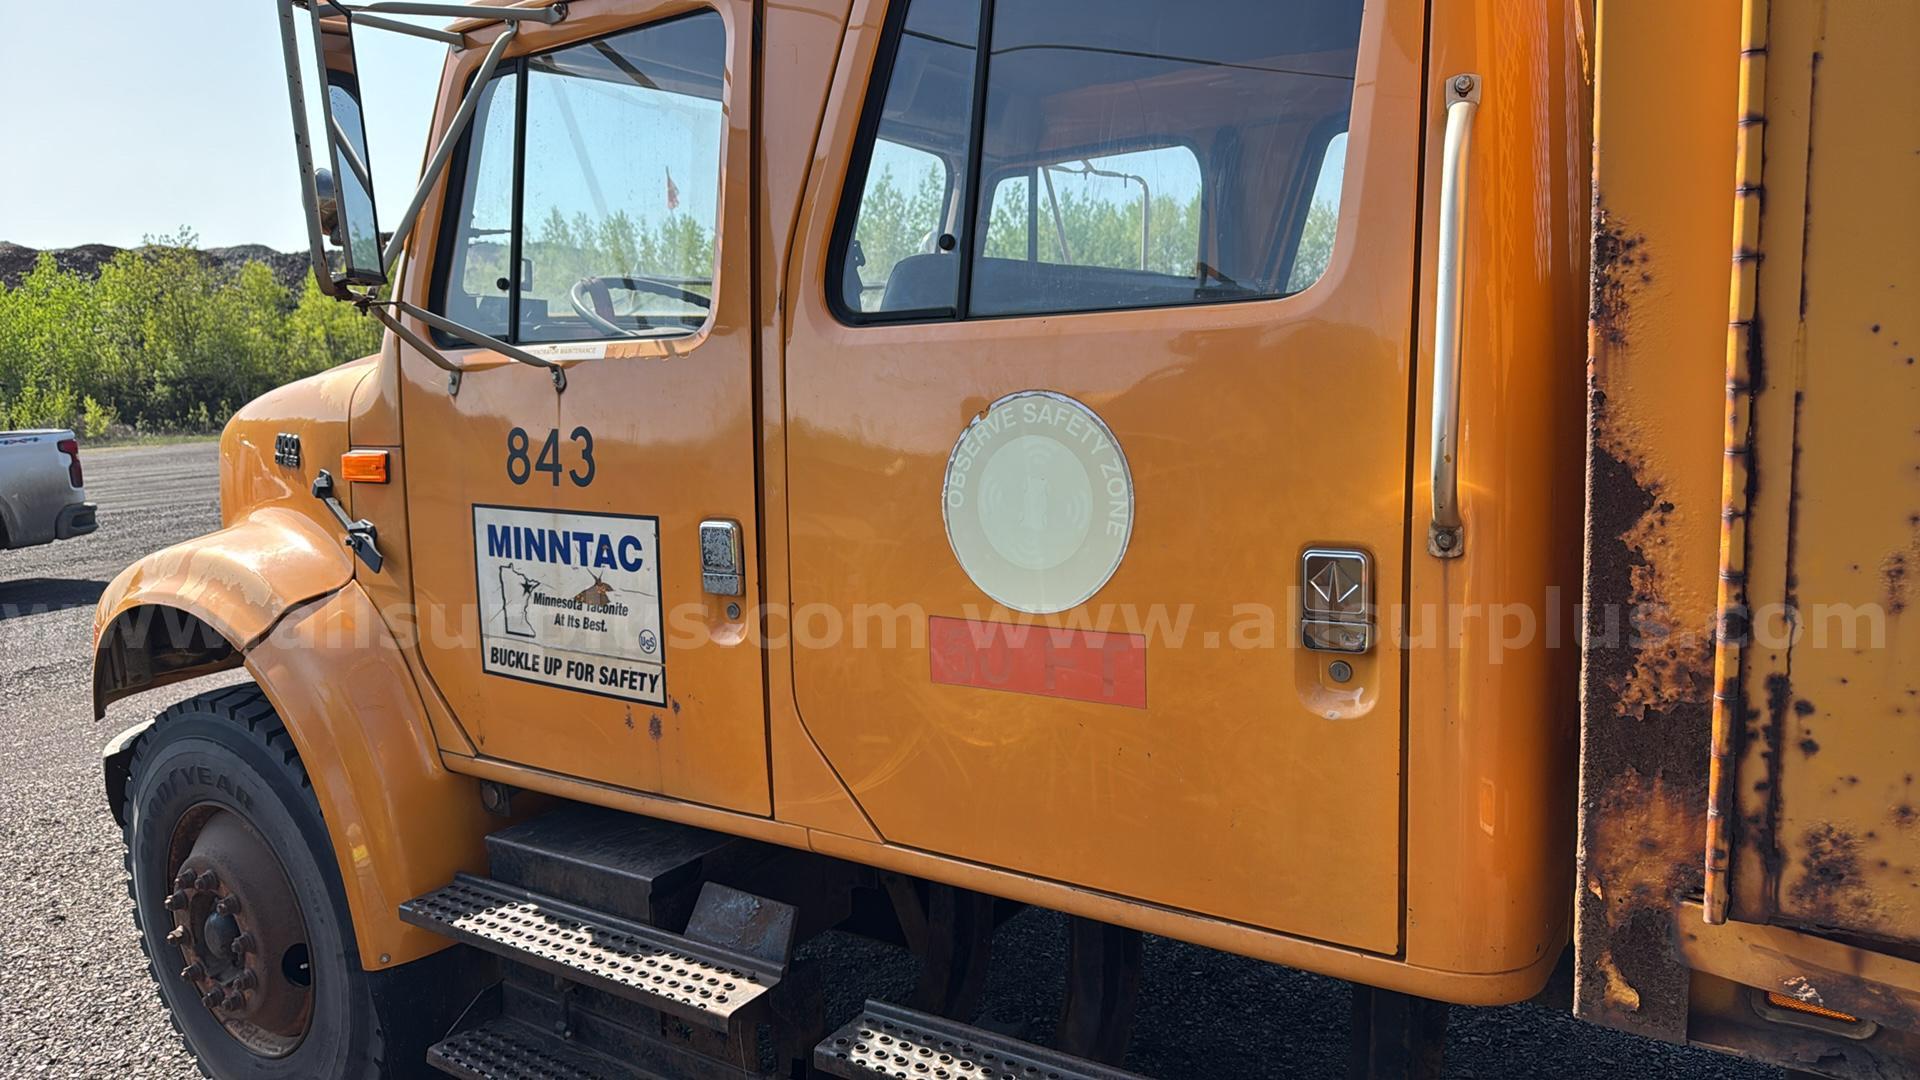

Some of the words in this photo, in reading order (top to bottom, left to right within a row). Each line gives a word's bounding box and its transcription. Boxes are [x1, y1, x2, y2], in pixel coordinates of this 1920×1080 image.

[507, 426, 595, 487] 843
[948, 407, 1017, 508] OBSERVE
[1023, 402, 1109, 455] SAFETY
[1100, 458, 1130, 537] ZONE
[487, 524, 643, 573] MINNTAC
[533, 592, 583, 611] Minnesota
[554, 613, 565, 626] At
[567, 614, 580, 628] Its
[583, 617, 607, 632] Best.
[490, 647, 540, 672] BUCKLE
[543, 656, 563, 676] UP
[566, 660, 595, 683] FOR
[599, 666, 659, 693] SAFETY
